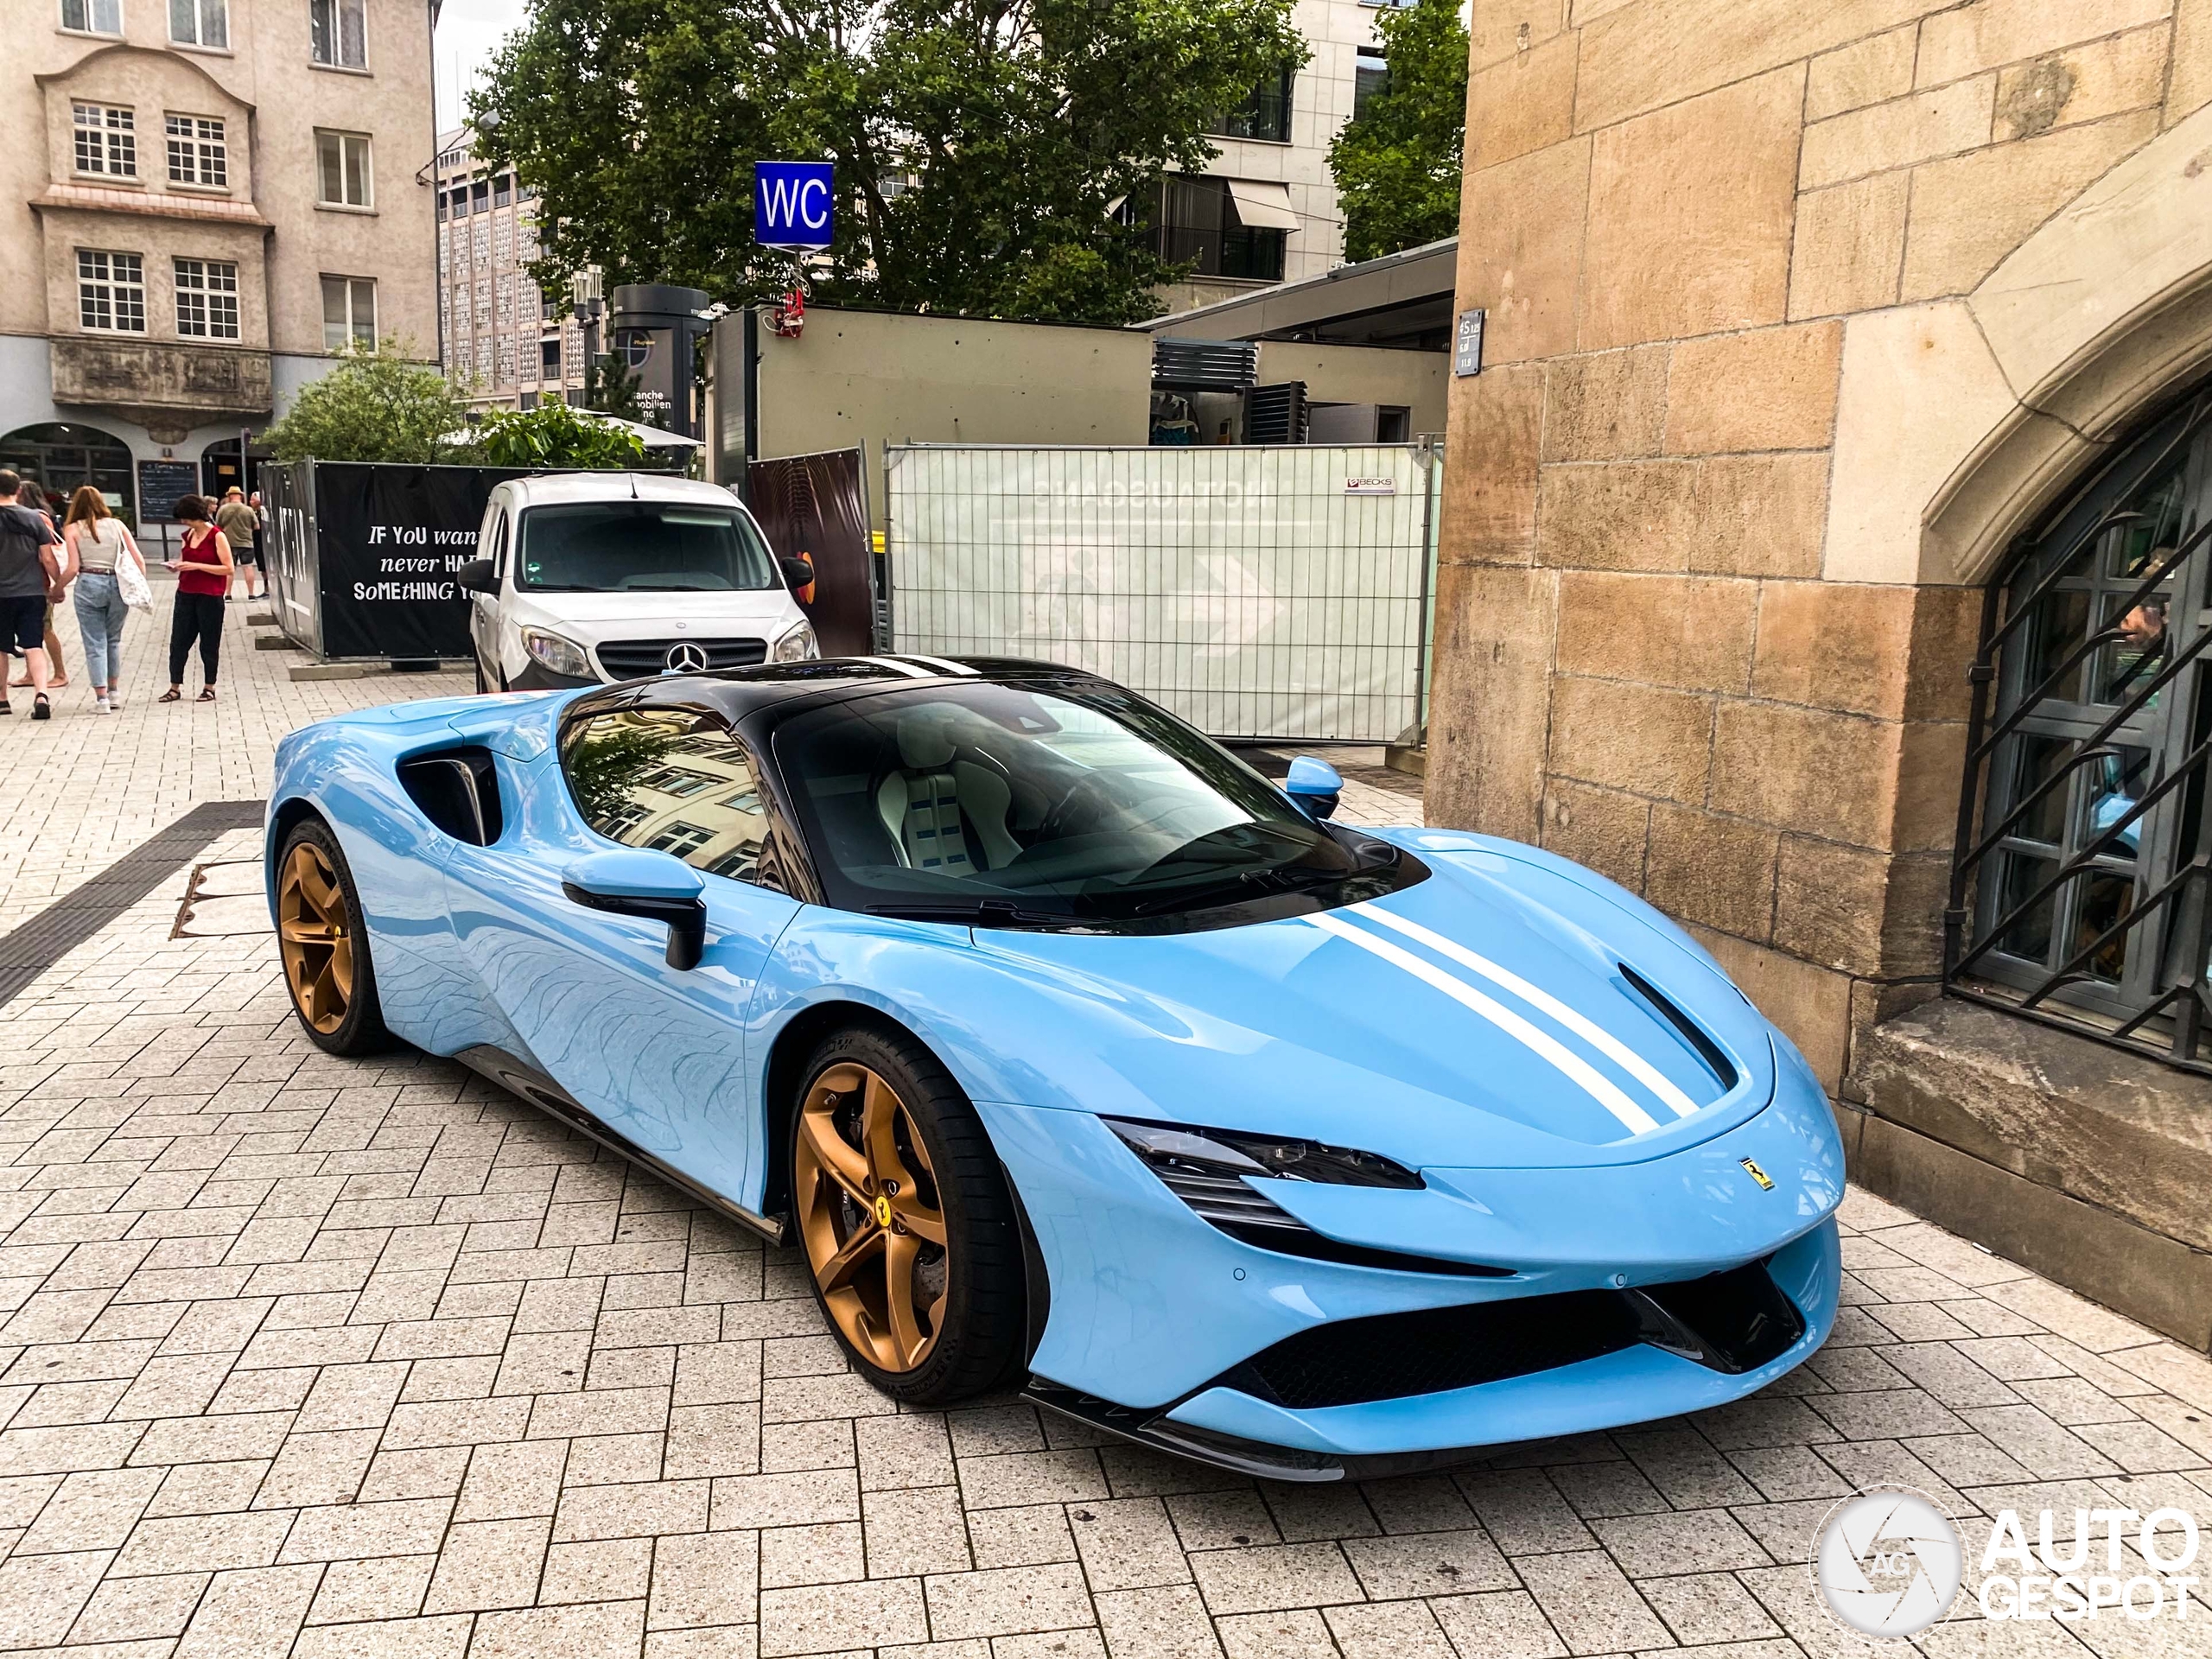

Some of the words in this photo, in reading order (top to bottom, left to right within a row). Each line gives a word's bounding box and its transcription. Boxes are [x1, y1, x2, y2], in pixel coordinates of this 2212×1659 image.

[761, 178, 827, 229] WC
[368, 526, 386, 544] IF
[392, 526, 427, 545] YoU
[434, 531, 481, 545] wan
[380, 558, 440, 572] never
[353, 582, 454, 601] SoMEtHING
